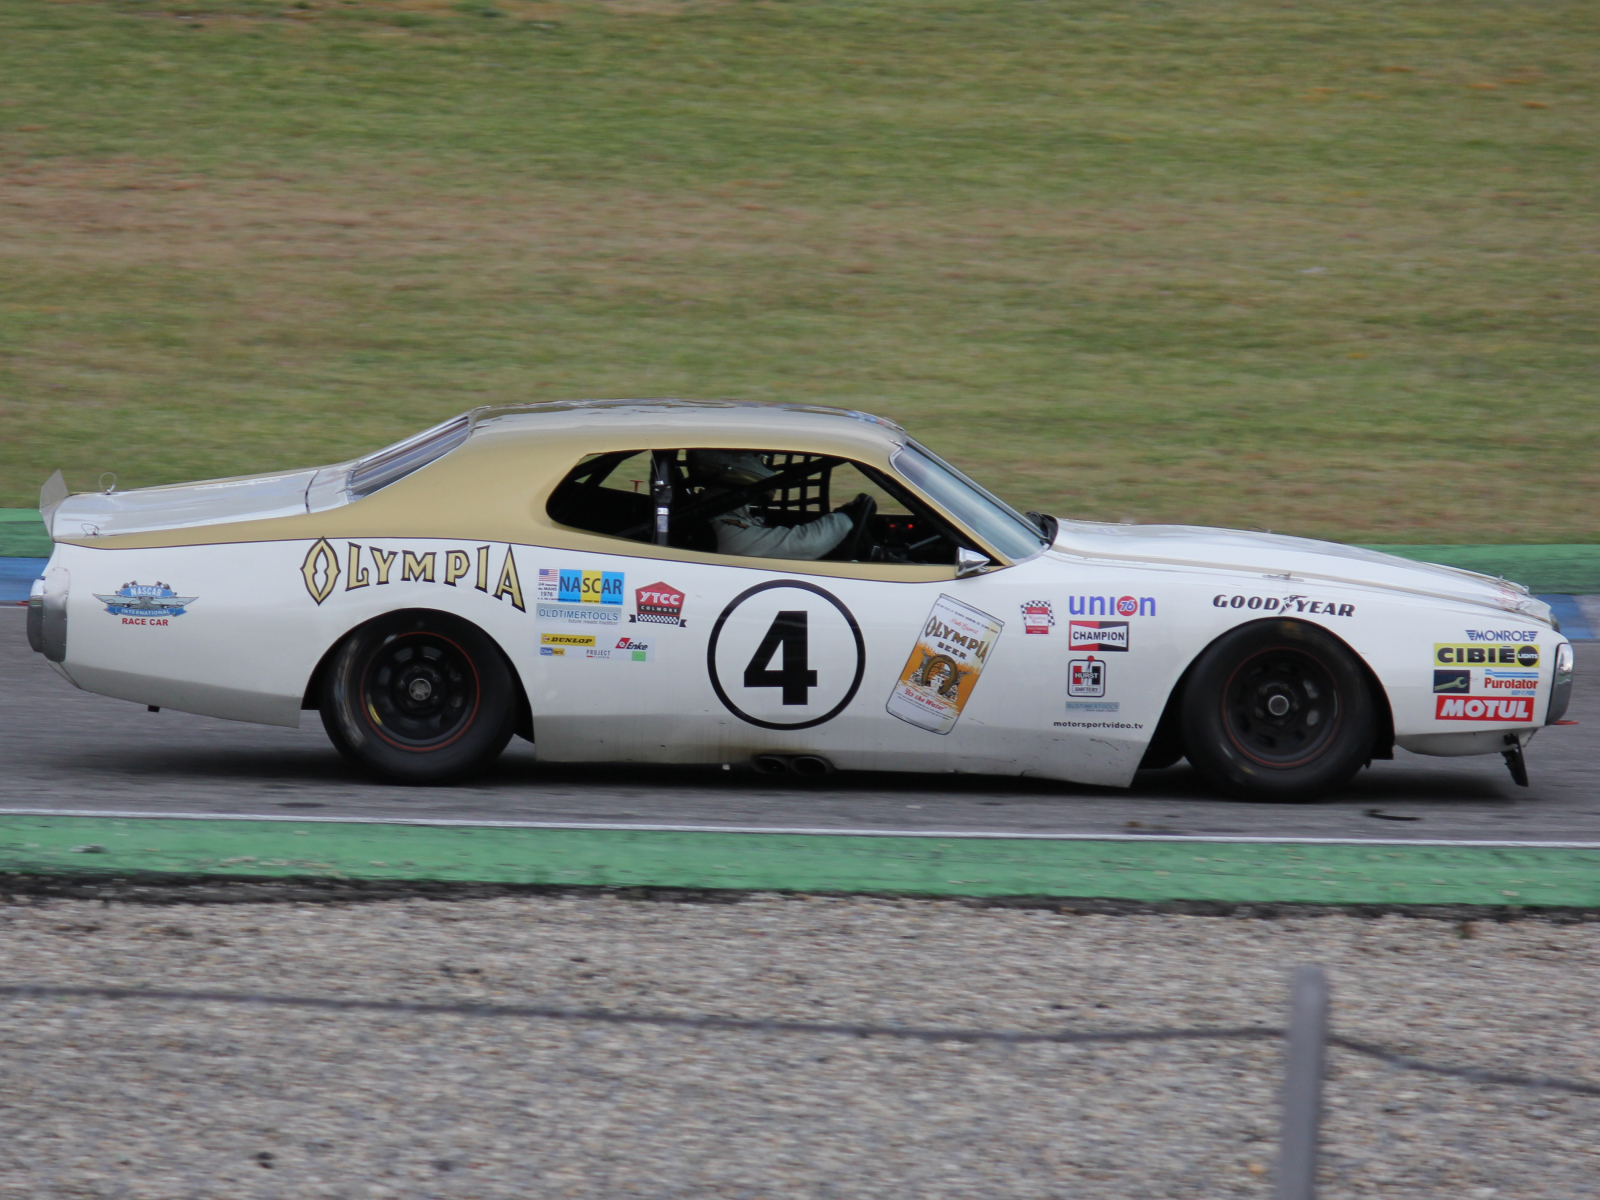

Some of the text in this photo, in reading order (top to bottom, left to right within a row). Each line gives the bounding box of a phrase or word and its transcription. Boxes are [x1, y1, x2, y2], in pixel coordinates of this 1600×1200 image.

[300, 536, 526, 613] OLYMPIA
[130, 586, 163, 597] NASCAR
[559, 575, 622, 595] NASCAR
[640, 591, 680, 605] YTCC
[120, 607, 170, 616] INTERNATIONAL
[640, 605, 678, 613] COLMORE
[1119, 600, 1136, 612] 76
[538, 608, 619, 621] OLDTIMERTOOLS
[122, 617, 169, 627] RACE CAR
[551, 636, 593, 644] DUNLOP
[924, 614, 991, 665] OLYMPIA
[1072, 631, 1126, 641] CHAMPION
[1474, 629, 1531, 642] MONROE
[586, 649, 611, 657] PROJECT
[937, 641, 968, 660] BEER
[743, 610, 818, 706] 4
[1484, 677, 1539, 690] Purolator
[1439, 698, 1530, 719] MOTUL
[1053, 720, 1144, 730] motorsportvideo.tv
